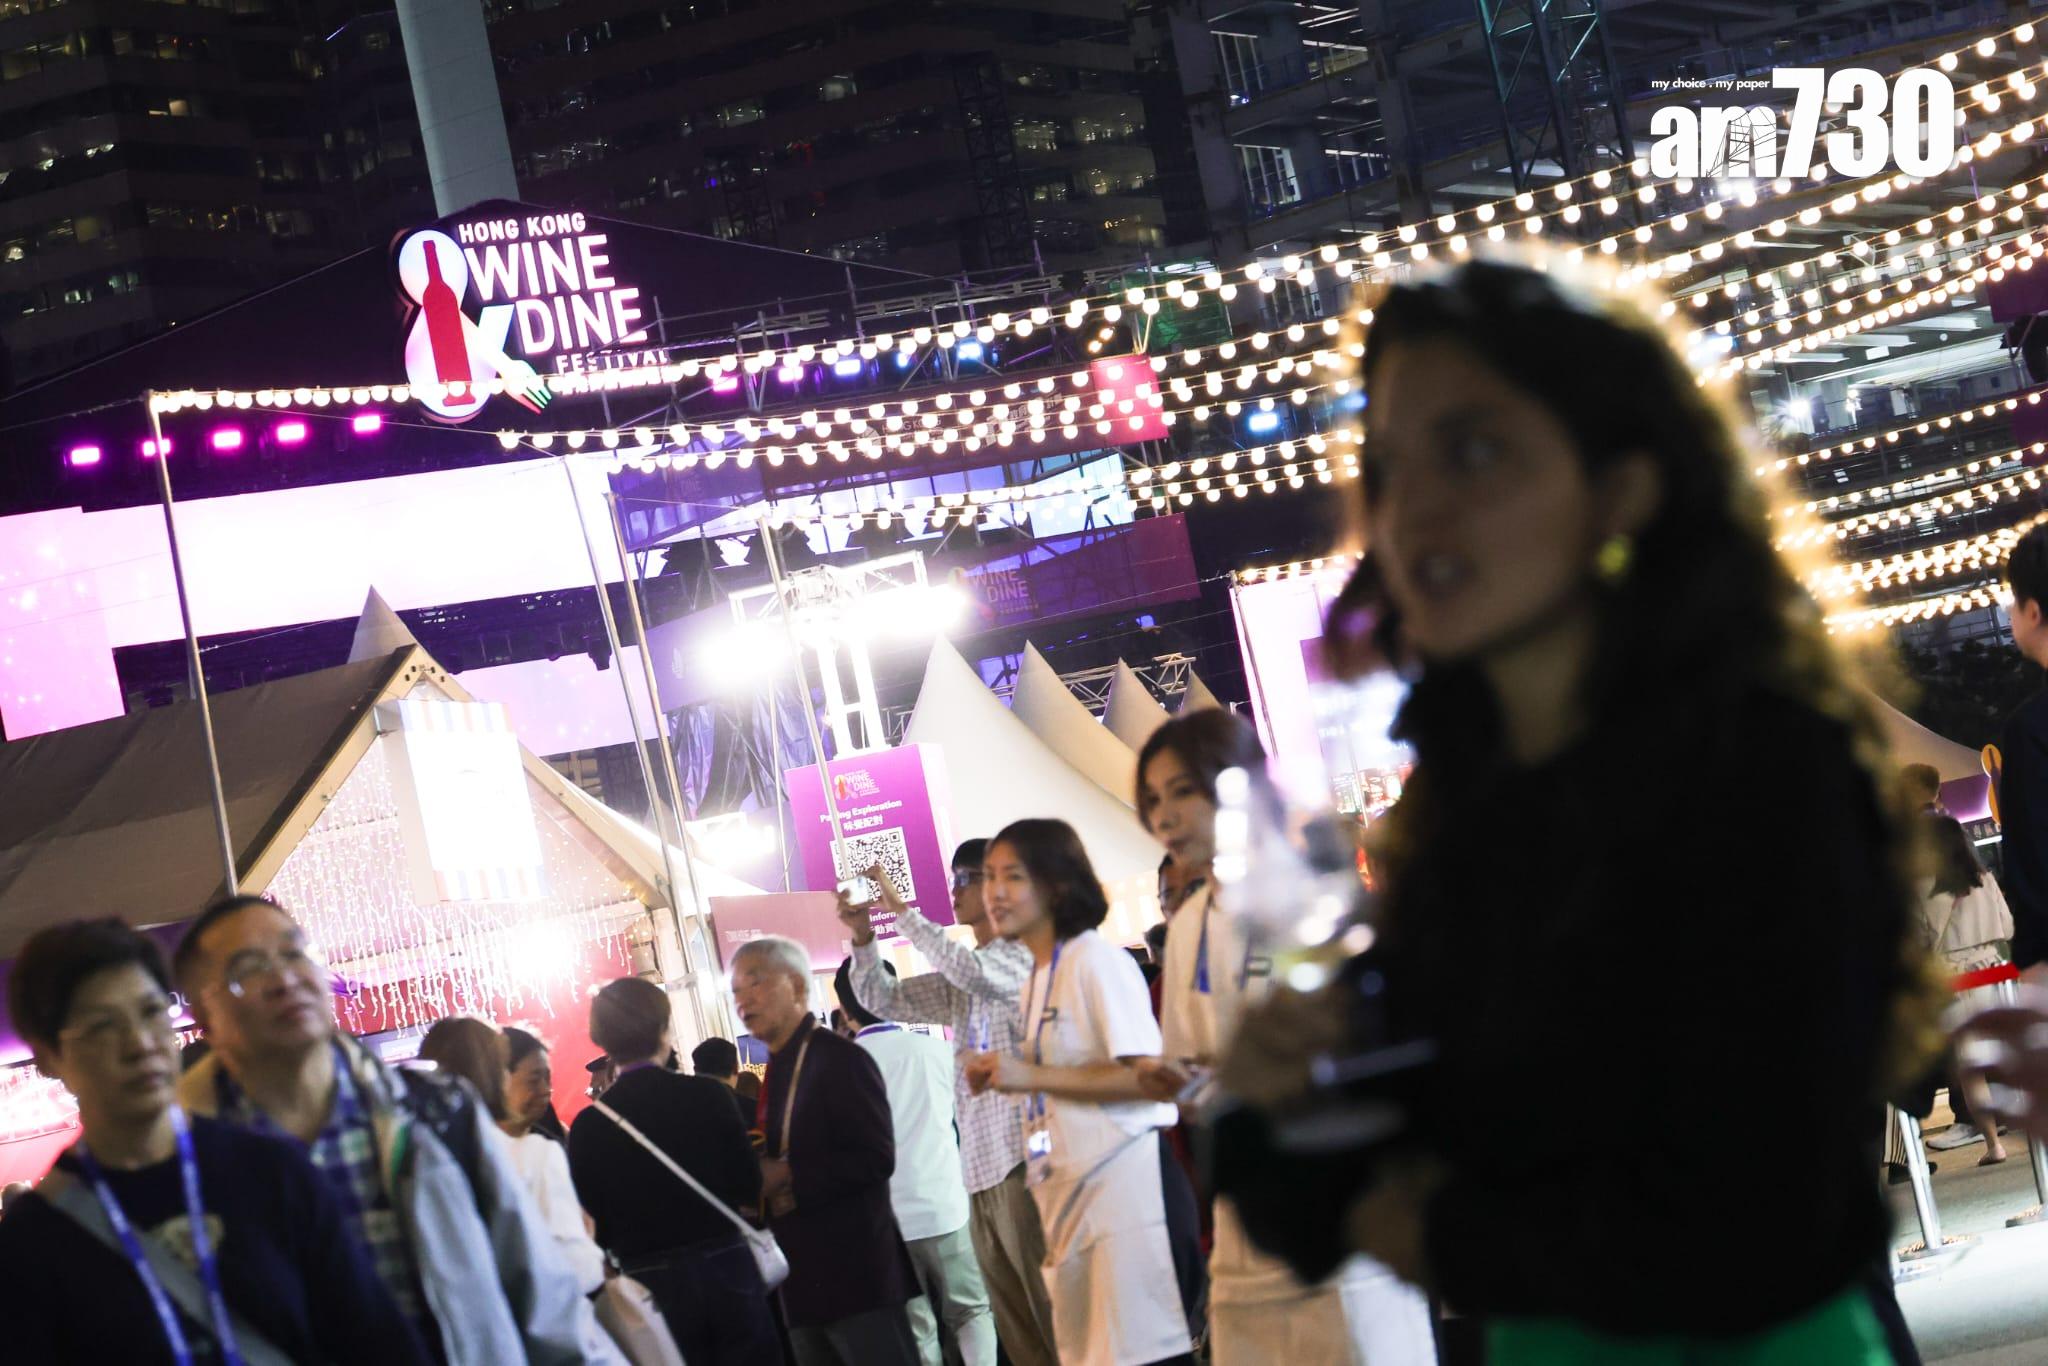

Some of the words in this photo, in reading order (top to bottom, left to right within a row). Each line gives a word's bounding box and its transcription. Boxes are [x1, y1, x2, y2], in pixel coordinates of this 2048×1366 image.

[458, 218, 519, 244] HONG
[525, 211, 586, 236] KONG
[463, 233, 616, 301] WINE
[514, 287, 648, 355] DINE
[972, 568, 1019, 587] WINE
[986, 581, 1029, 602] DINE
[846, 772, 870, 784] WINE
[854, 779, 876, 791] DINE
[851, 800, 903, 816] Exploration
